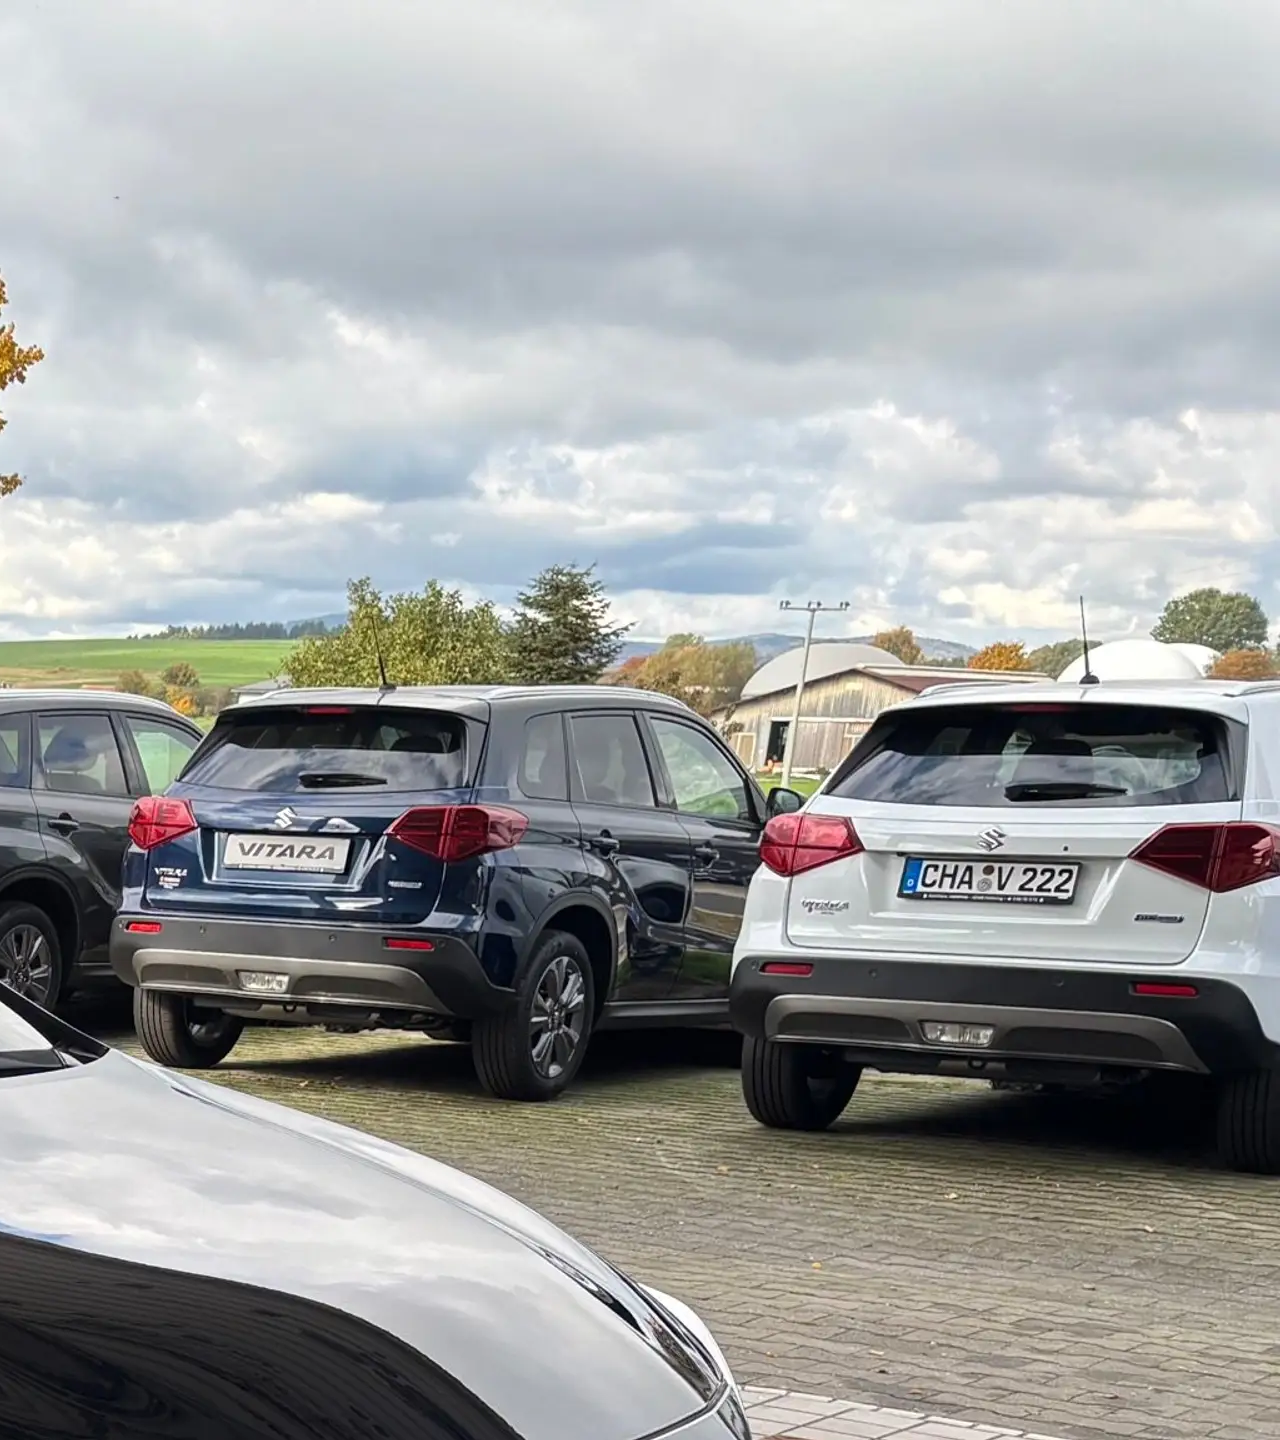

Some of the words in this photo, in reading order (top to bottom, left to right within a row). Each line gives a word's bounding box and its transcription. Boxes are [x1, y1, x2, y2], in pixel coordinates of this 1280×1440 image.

[239, 842, 336, 861] VITARA
[921, 863, 974, 890] CHA
[997, 866, 1015, 891] V
[1018, 867, 1074, 893] 222
